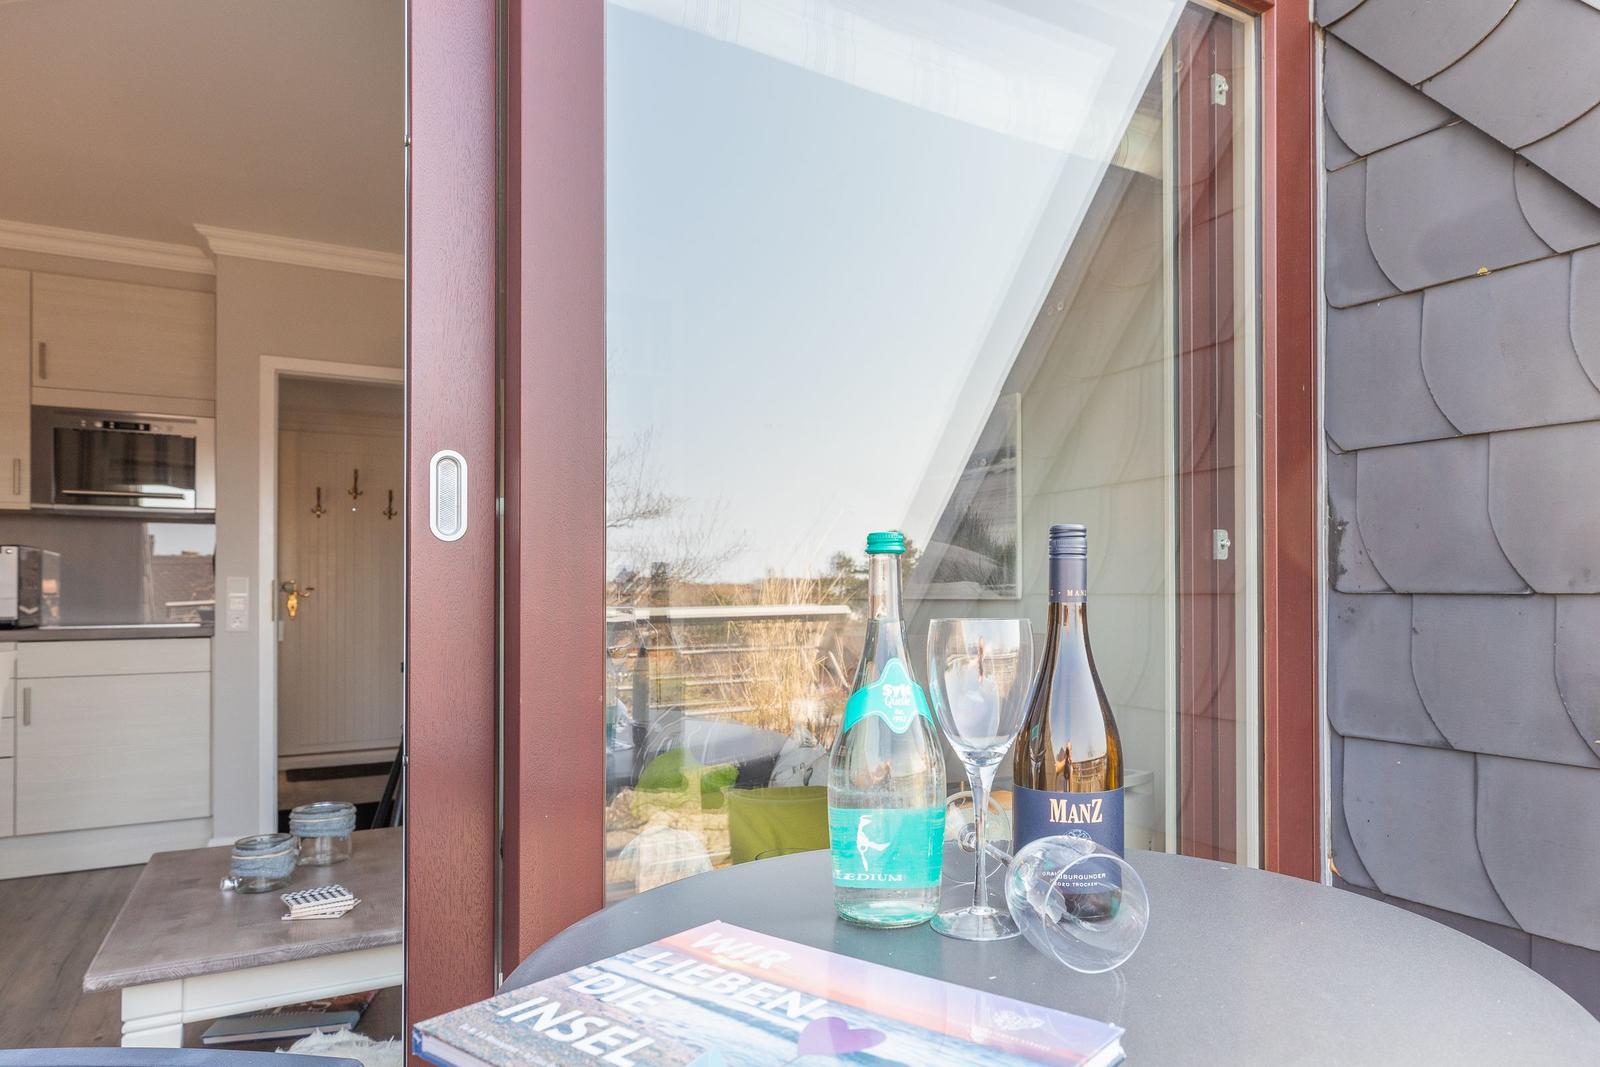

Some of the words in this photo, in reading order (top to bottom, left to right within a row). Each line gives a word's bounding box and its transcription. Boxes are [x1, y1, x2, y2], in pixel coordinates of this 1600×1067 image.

[1049, 798, 1103, 824] MANZ
[690, 932, 793, 970] WIR
[569, 972, 676, 1014] DIE
[632, 951, 829, 1019] LIEBEN
[497, 996, 655, 1067] INSEL
